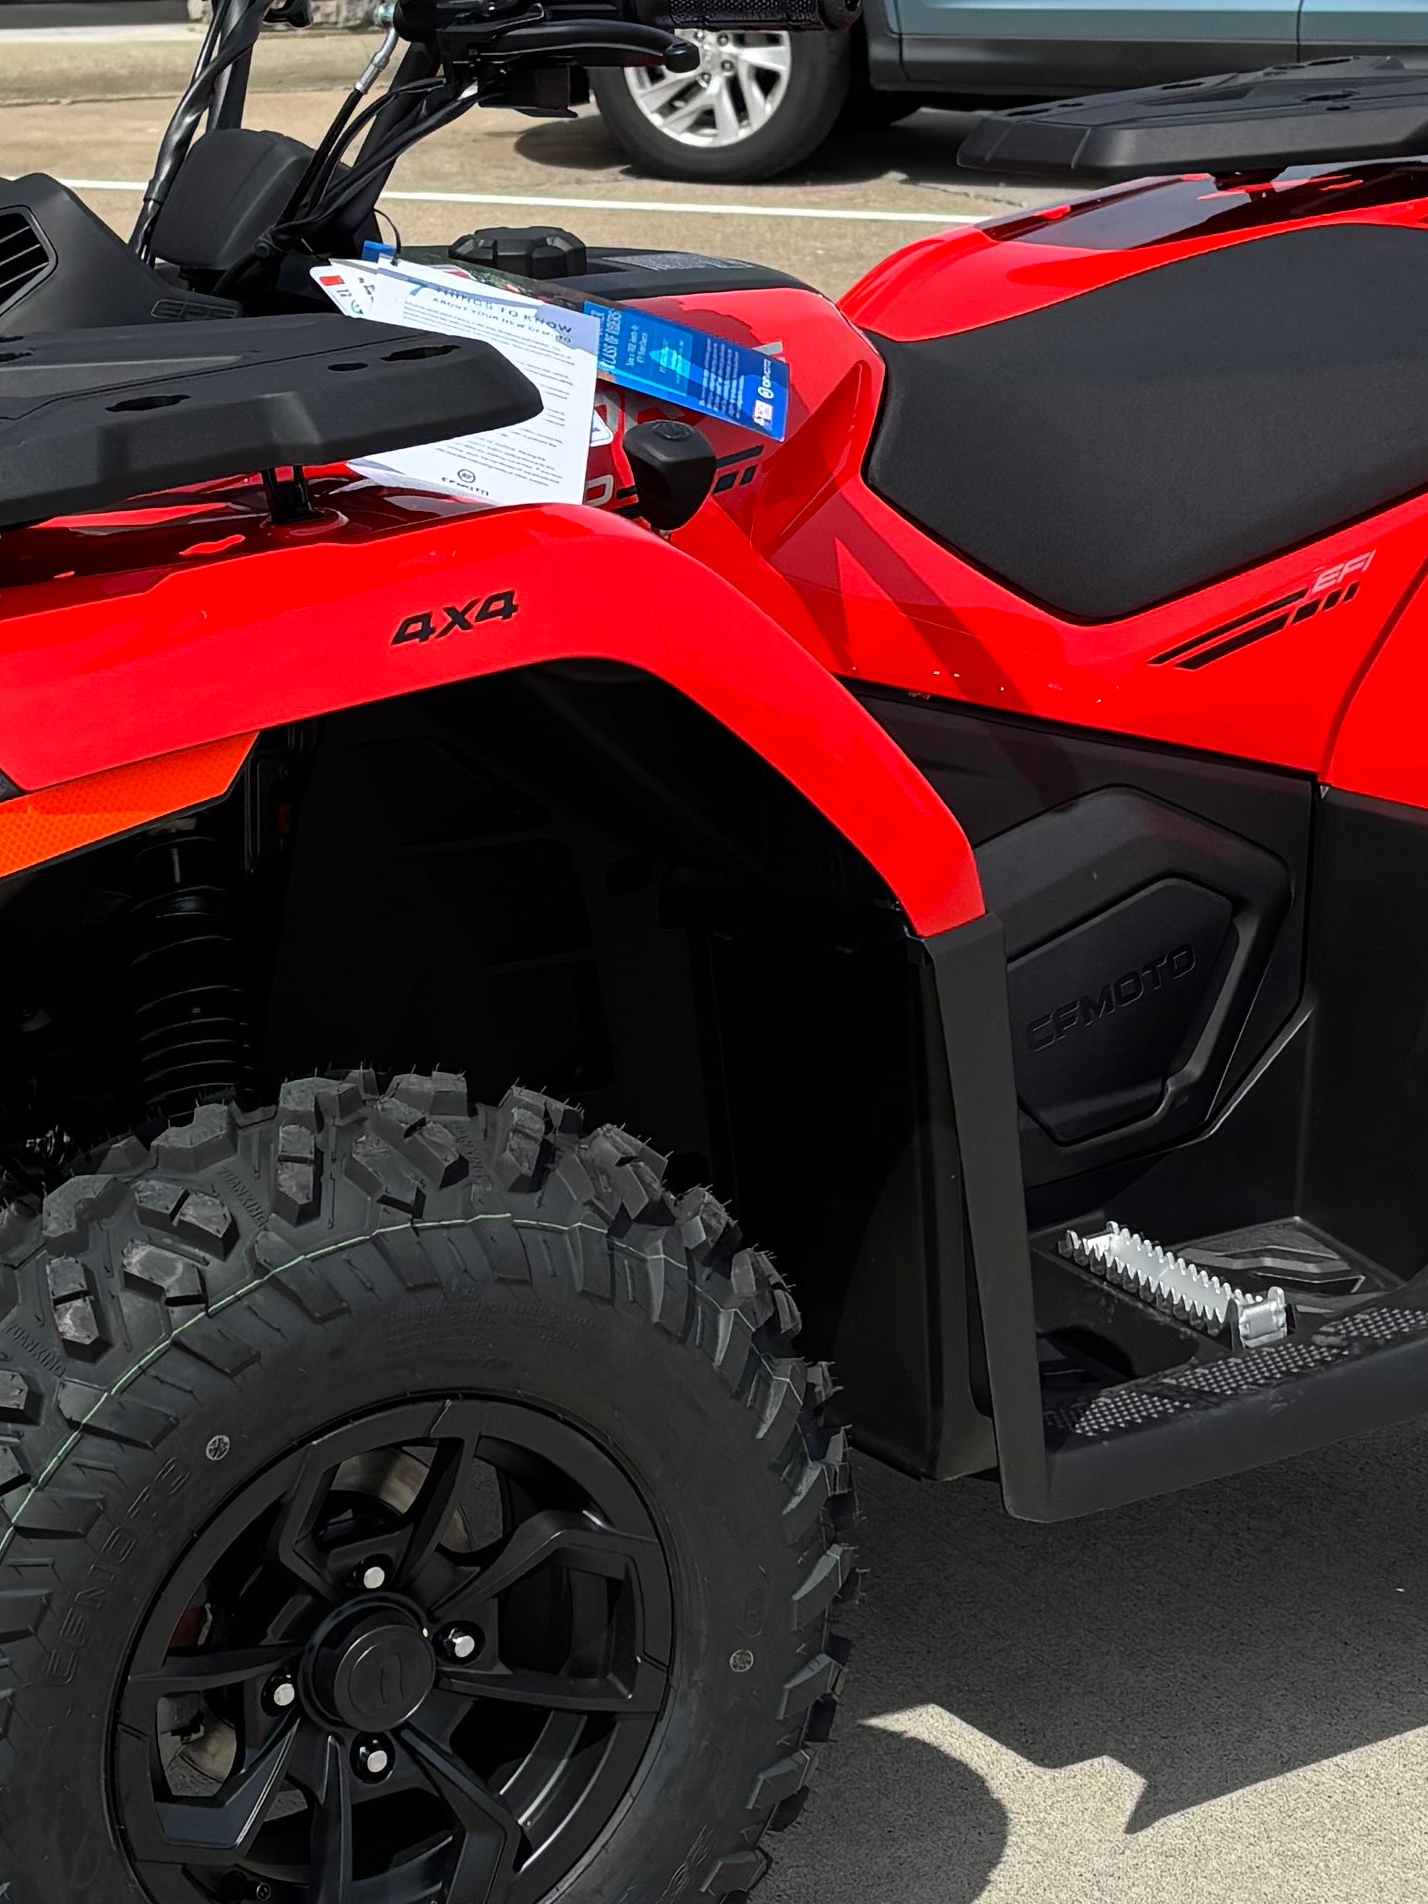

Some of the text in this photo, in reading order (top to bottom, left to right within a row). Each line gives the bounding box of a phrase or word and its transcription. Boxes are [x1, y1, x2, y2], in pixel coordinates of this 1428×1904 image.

[501, 306, 519, 318] TO
[524, 313, 572, 334] KNOW
[1311, 549, 1377, 594] EFI
[1026, 943, 1197, 1053] CFMOTO
